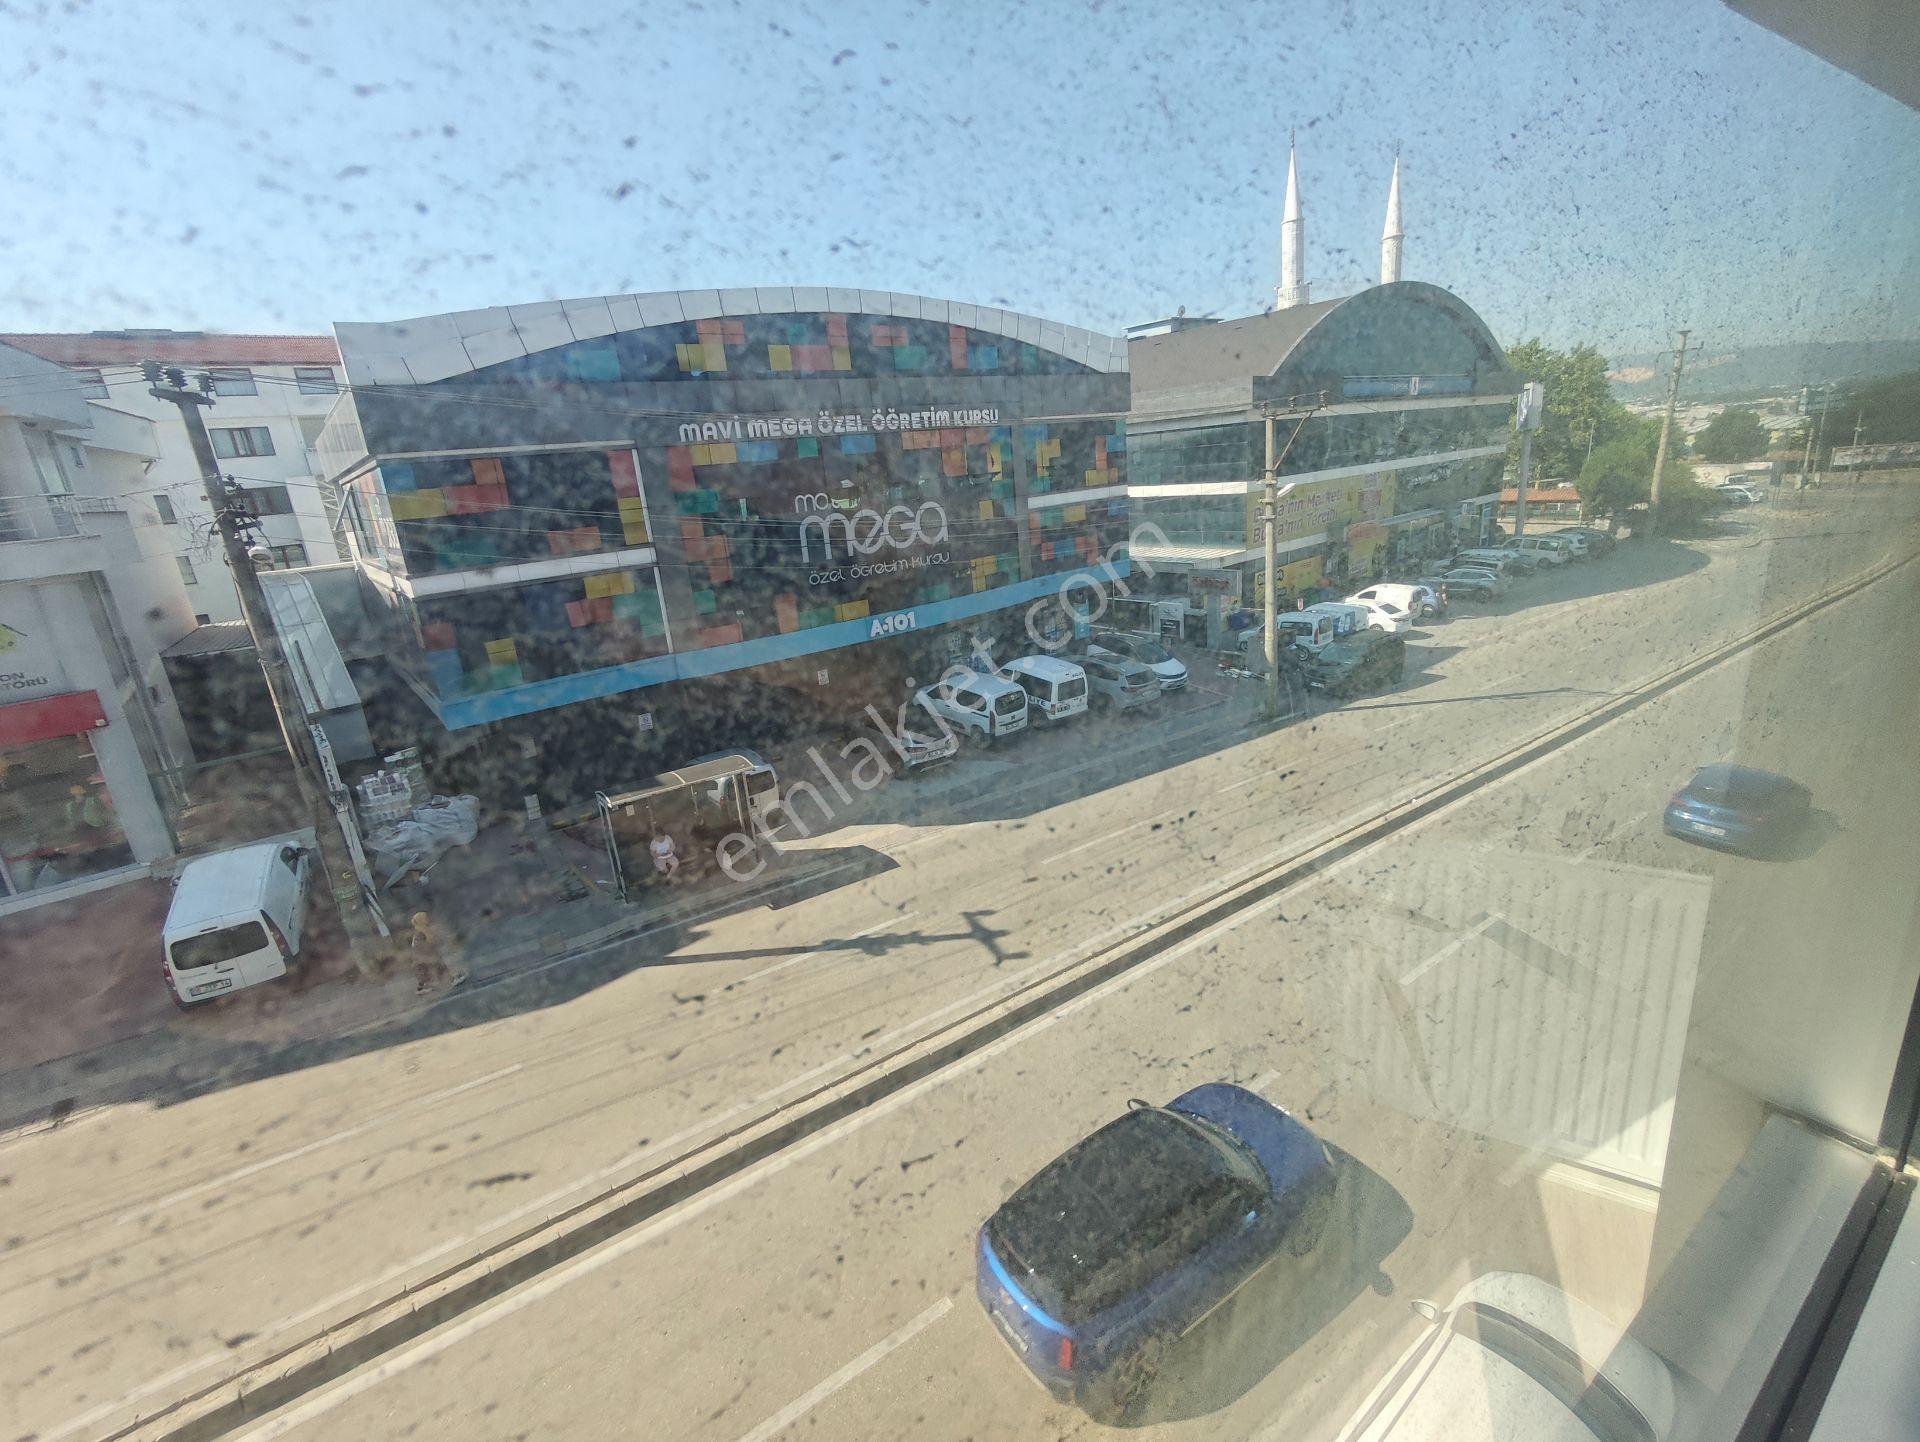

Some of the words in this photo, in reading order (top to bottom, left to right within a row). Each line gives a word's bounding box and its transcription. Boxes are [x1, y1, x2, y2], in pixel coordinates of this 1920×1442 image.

[679, 415, 742, 443] MAVİ
[748, 417, 812, 438] MEGA
[818, 410, 868, 434] ÖZEL
[953, 408, 999, 426] KURSU
[808, 567, 846, 586] özel
